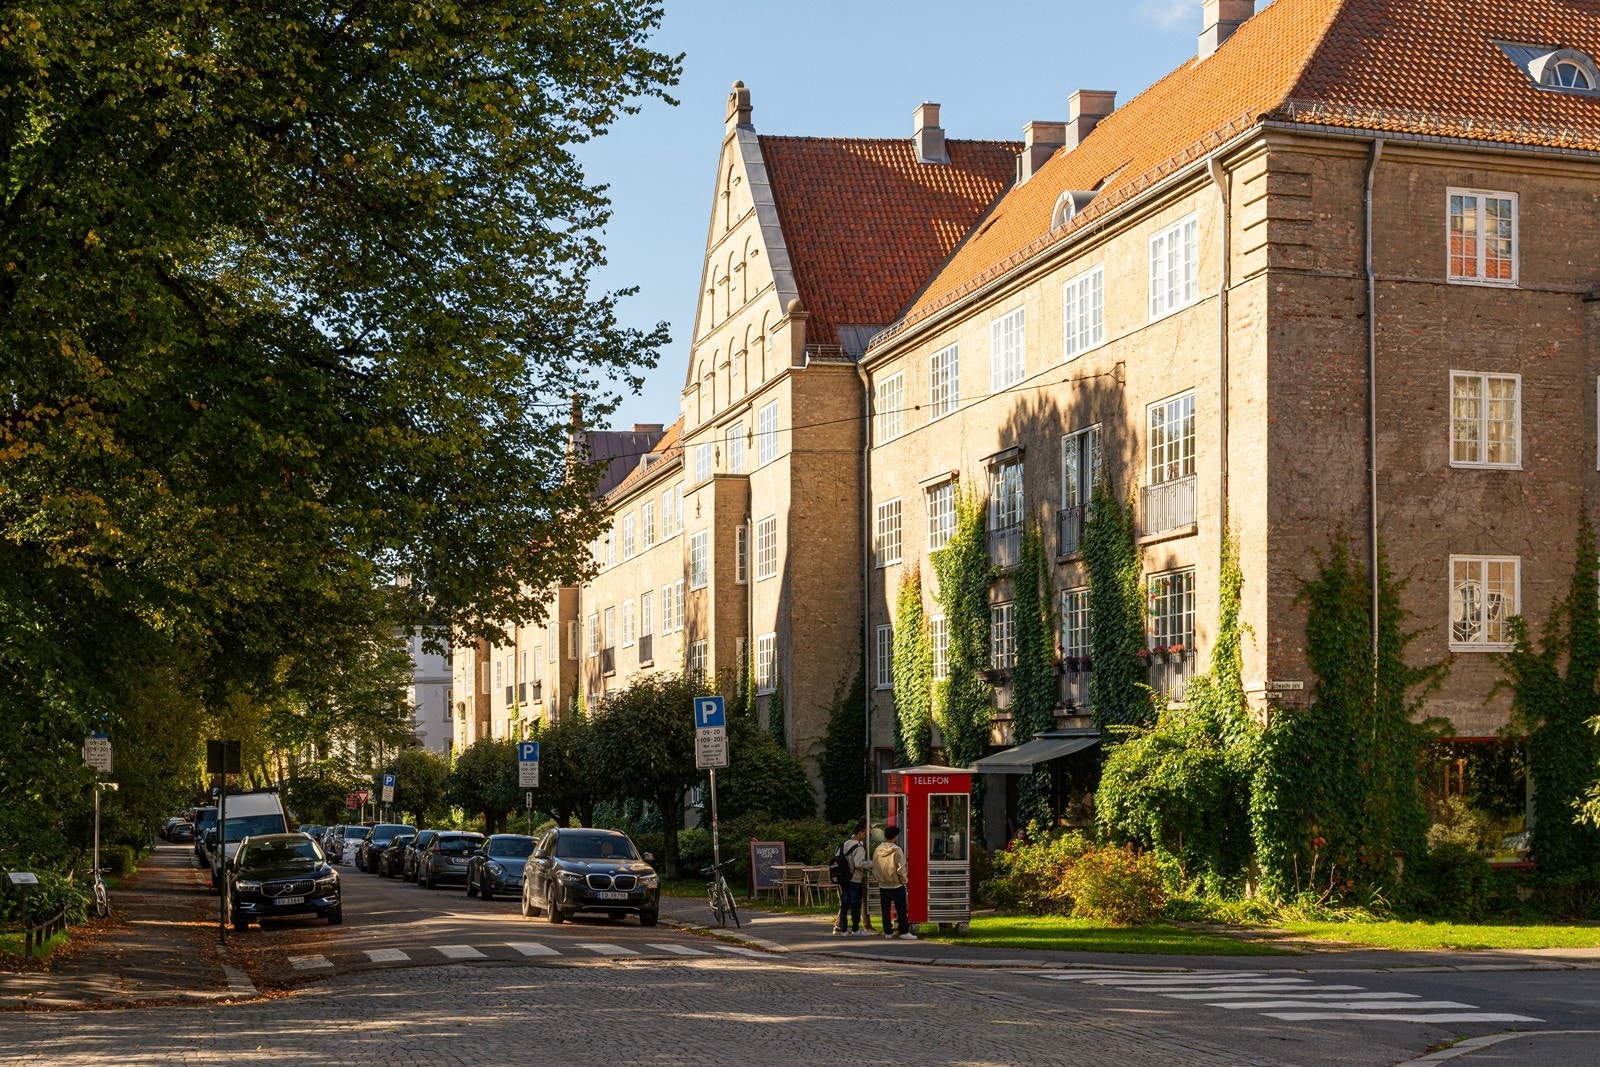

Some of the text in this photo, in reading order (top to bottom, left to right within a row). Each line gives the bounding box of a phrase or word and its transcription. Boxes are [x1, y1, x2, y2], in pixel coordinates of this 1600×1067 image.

[702, 701, 717, 724] P
[523, 745, 534, 760] P
[386, 776, 393, 785] P
[914, 777, 949, 785] TELEFON
